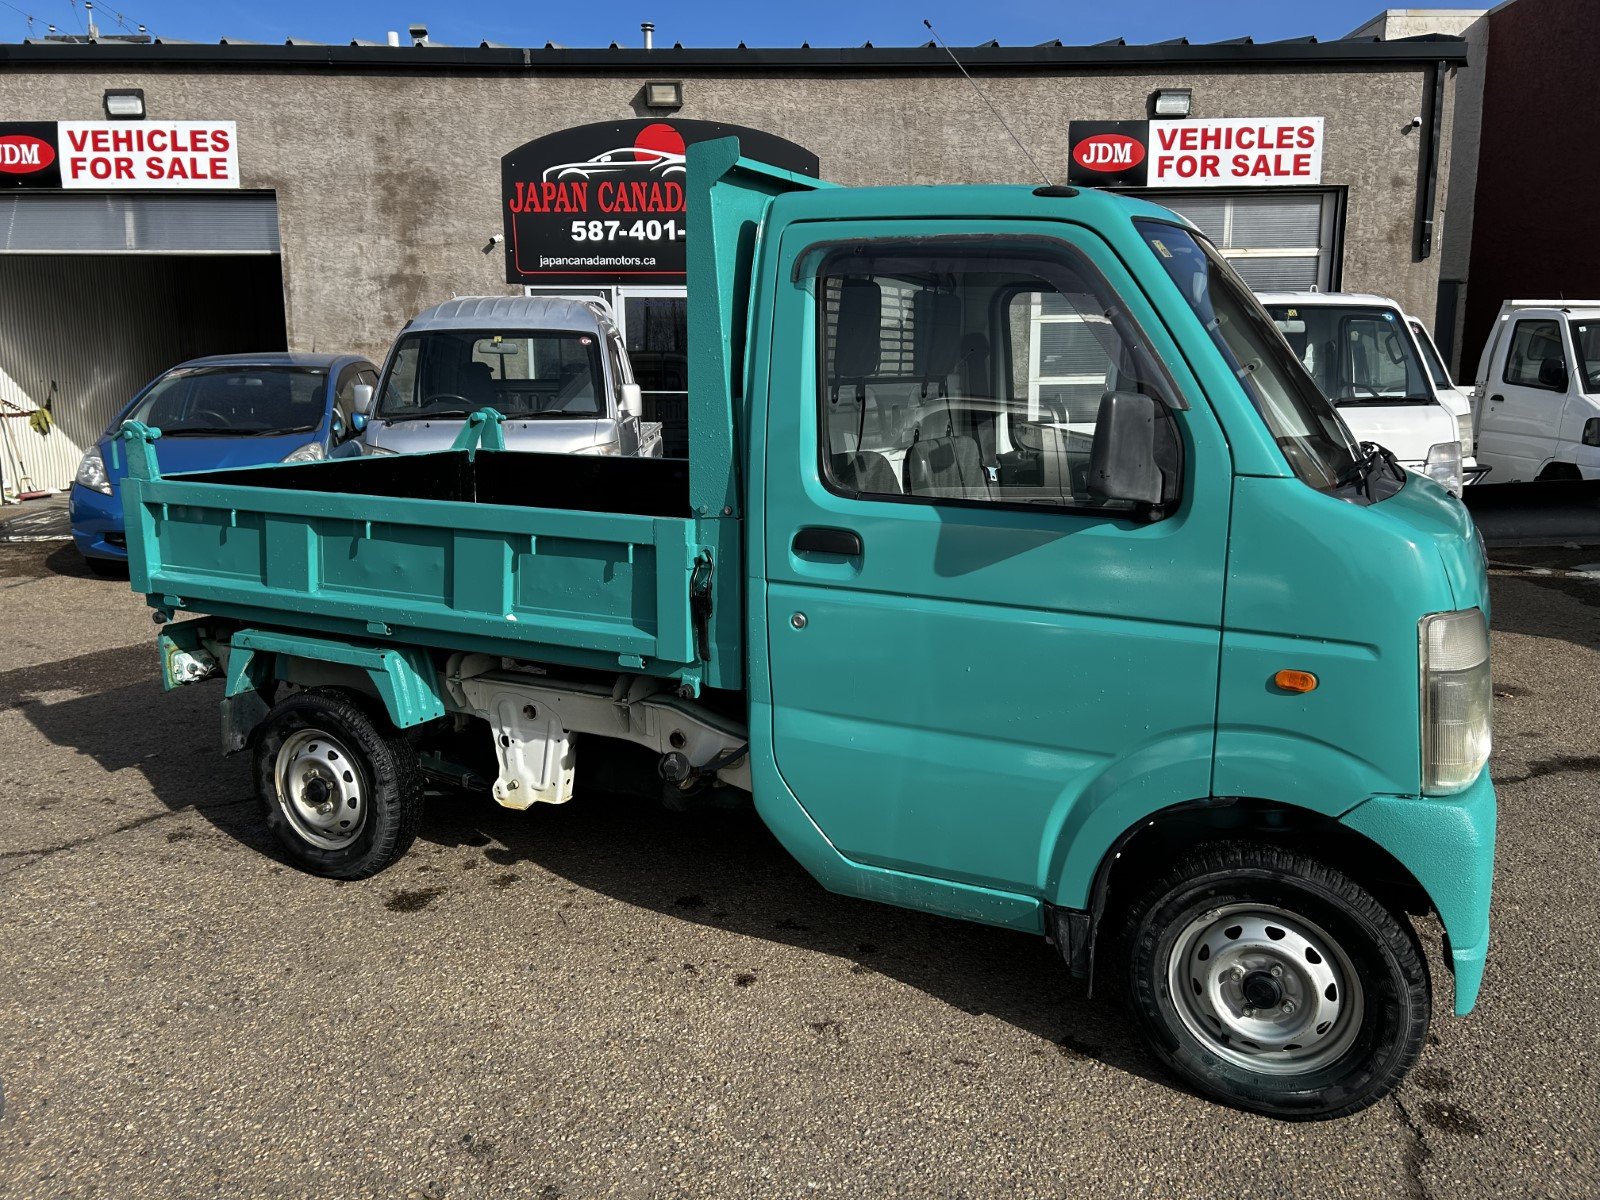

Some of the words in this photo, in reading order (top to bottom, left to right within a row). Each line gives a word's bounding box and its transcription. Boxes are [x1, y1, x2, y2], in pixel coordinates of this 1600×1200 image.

[67, 129, 230, 152] VEHICLES
[1157, 126, 1315, 150] VEHICLES
[0, 143, 41, 165] DM
[1082, 142, 1132, 164] JDM
[70, 157, 136, 180] FOR
[145, 157, 228, 180] SALE
[1157, 154, 1220, 178] FOR
[1231, 153, 1311, 177] SALE
[509, 181, 588, 213] JAPAN
[597, 181, 687, 213] CANAD
[539, 254, 656, 268] japancanadamotors.ca
